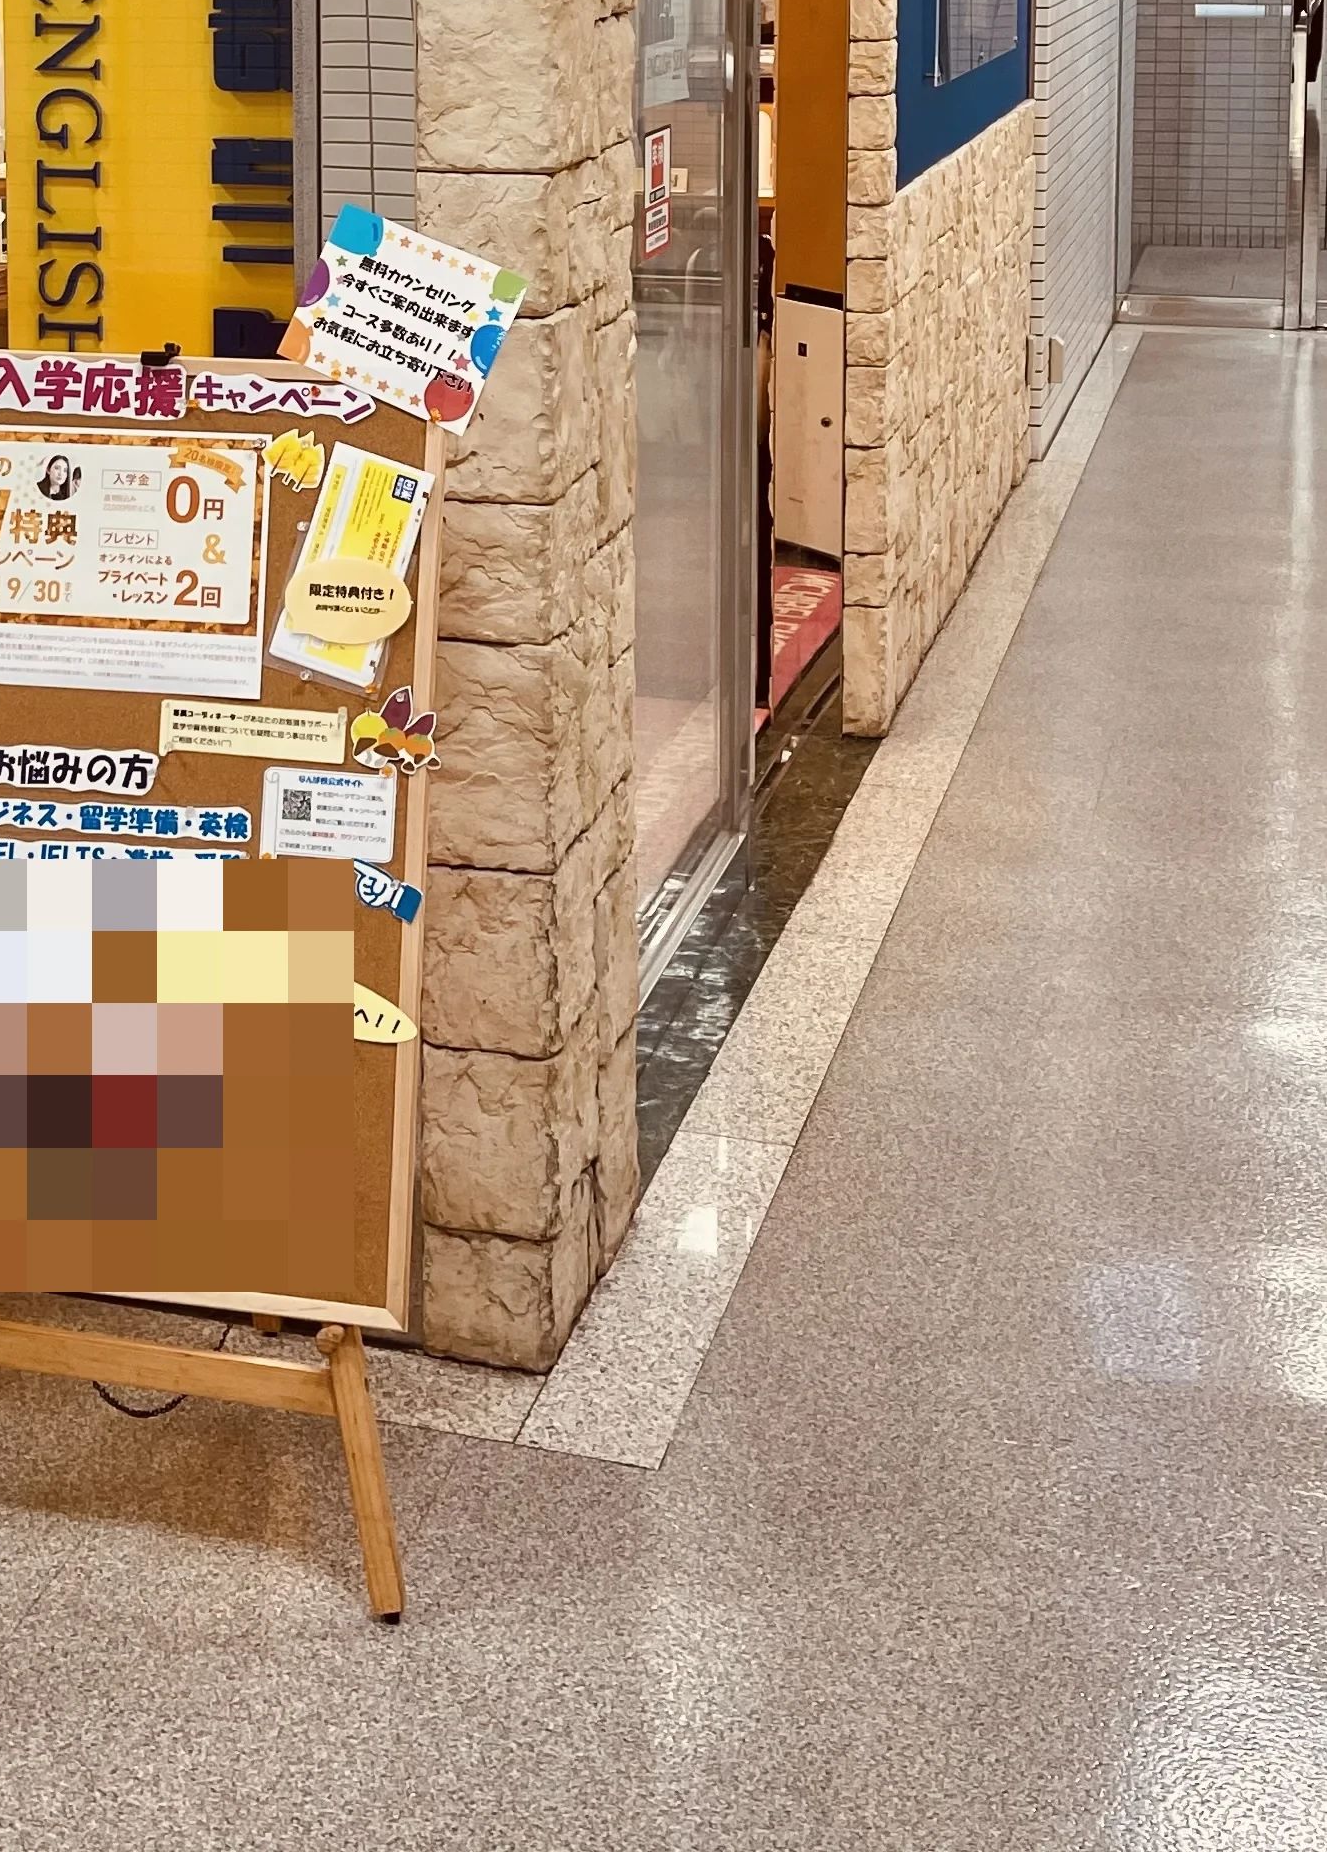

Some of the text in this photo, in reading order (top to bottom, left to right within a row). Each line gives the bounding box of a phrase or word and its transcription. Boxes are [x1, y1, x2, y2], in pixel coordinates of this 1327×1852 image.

[359, 255, 476, 313] 無料カウンセリング
[342, 273, 475, 338] 今すぐご案内出来ます
[313, 317, 472, 393] お気軽にお立ち寄り下さい
[195, 374, 371, 422] キャンペーン
[113, 473, 150, 486] 入学金
[103, 532, 154, 546] プレゼント
[203, 534, 227, 564] &
[99, 553, 172, 566] オンラインによる
[98, 570, 168, 586] プライベート
